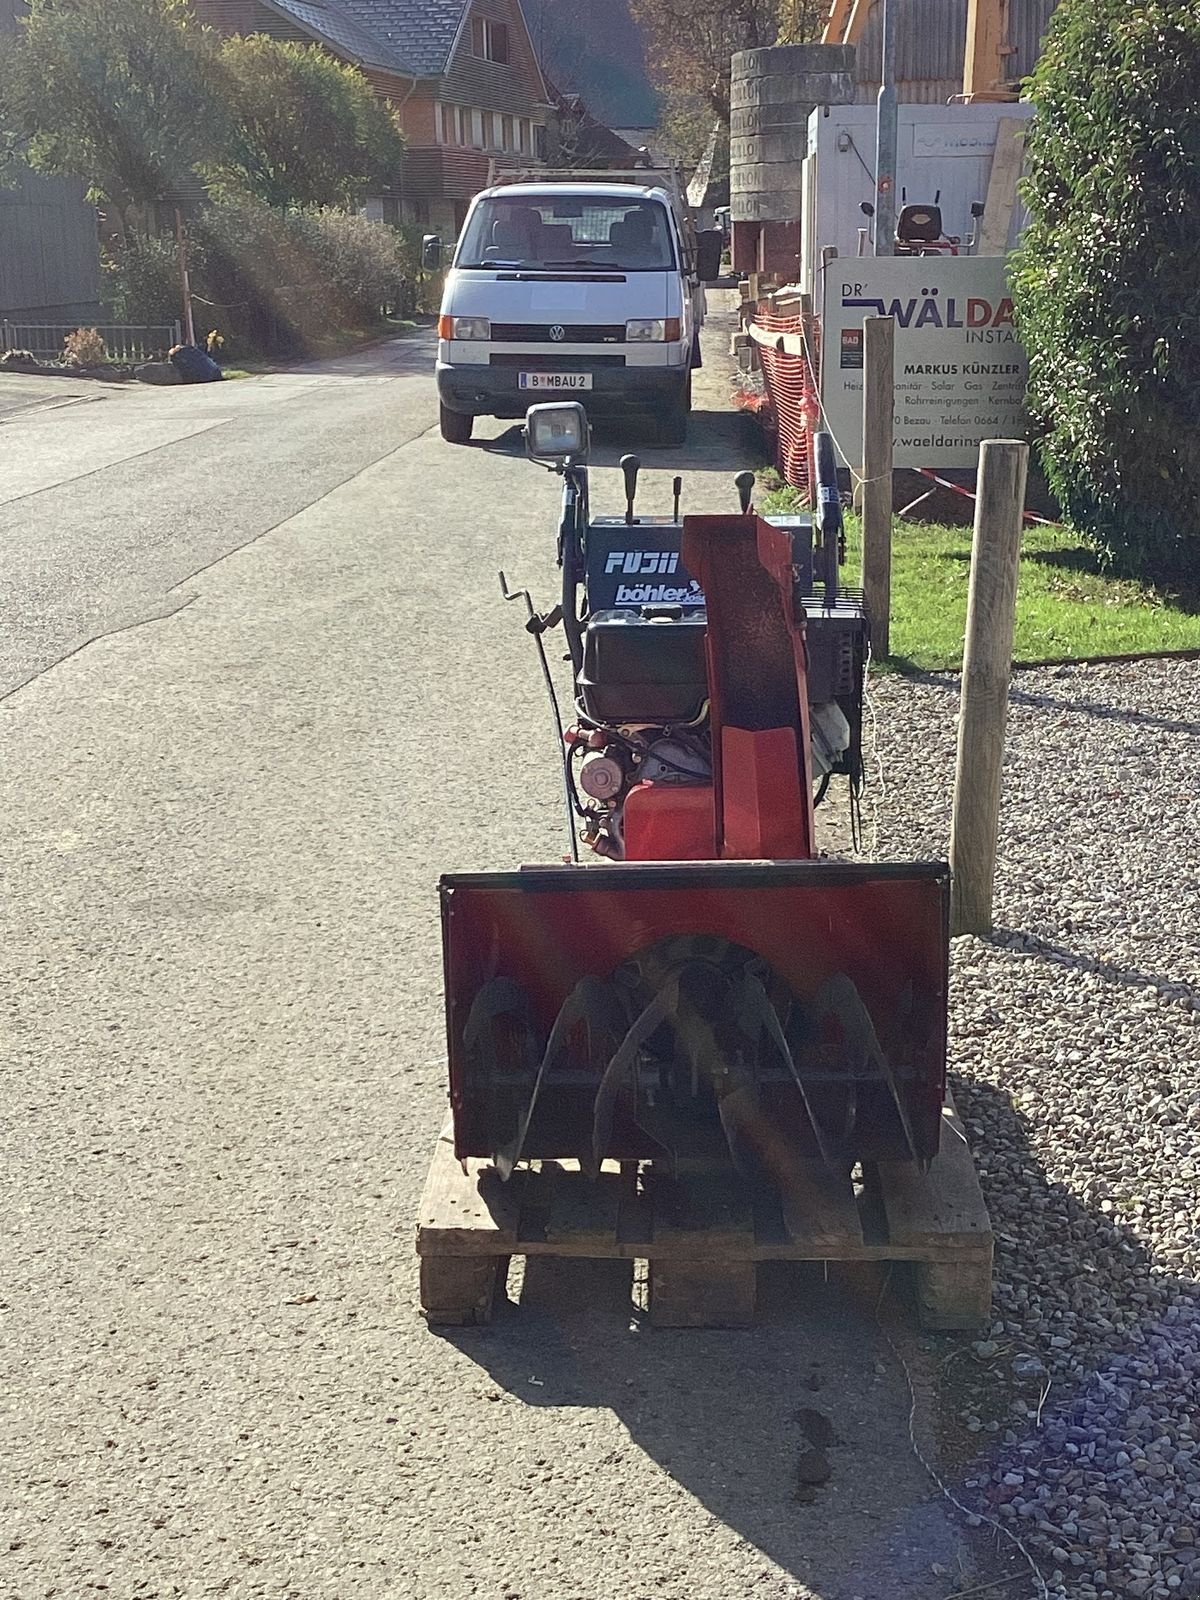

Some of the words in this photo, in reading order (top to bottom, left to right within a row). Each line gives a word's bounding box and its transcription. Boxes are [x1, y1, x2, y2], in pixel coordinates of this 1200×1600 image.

[842, 288, 1016, 328] WÄLDA
[966, 331, 1021, 343] INSTA
[904, 365, 958, 375] MARKUS
[962, 362, 1020, 375] KÜNZLER
[532, 376, 539, 387] B
[843, 381, 863, 391] Heiz
[931, 381, 955, 391] Solar
[964, 381, 983, 391] Gas
[992, 381, 1025, 391] Zentra
[905, 396, 979, 408] Rohrreinigungen
[988, 396, 1022, 406] Kernbo
[903, 415, 931, 425] Bezau
[940, 415, 972, 425] Telefon
[974, 415, 999, 425] 0664
[615, 584, 687, 602] böhler
